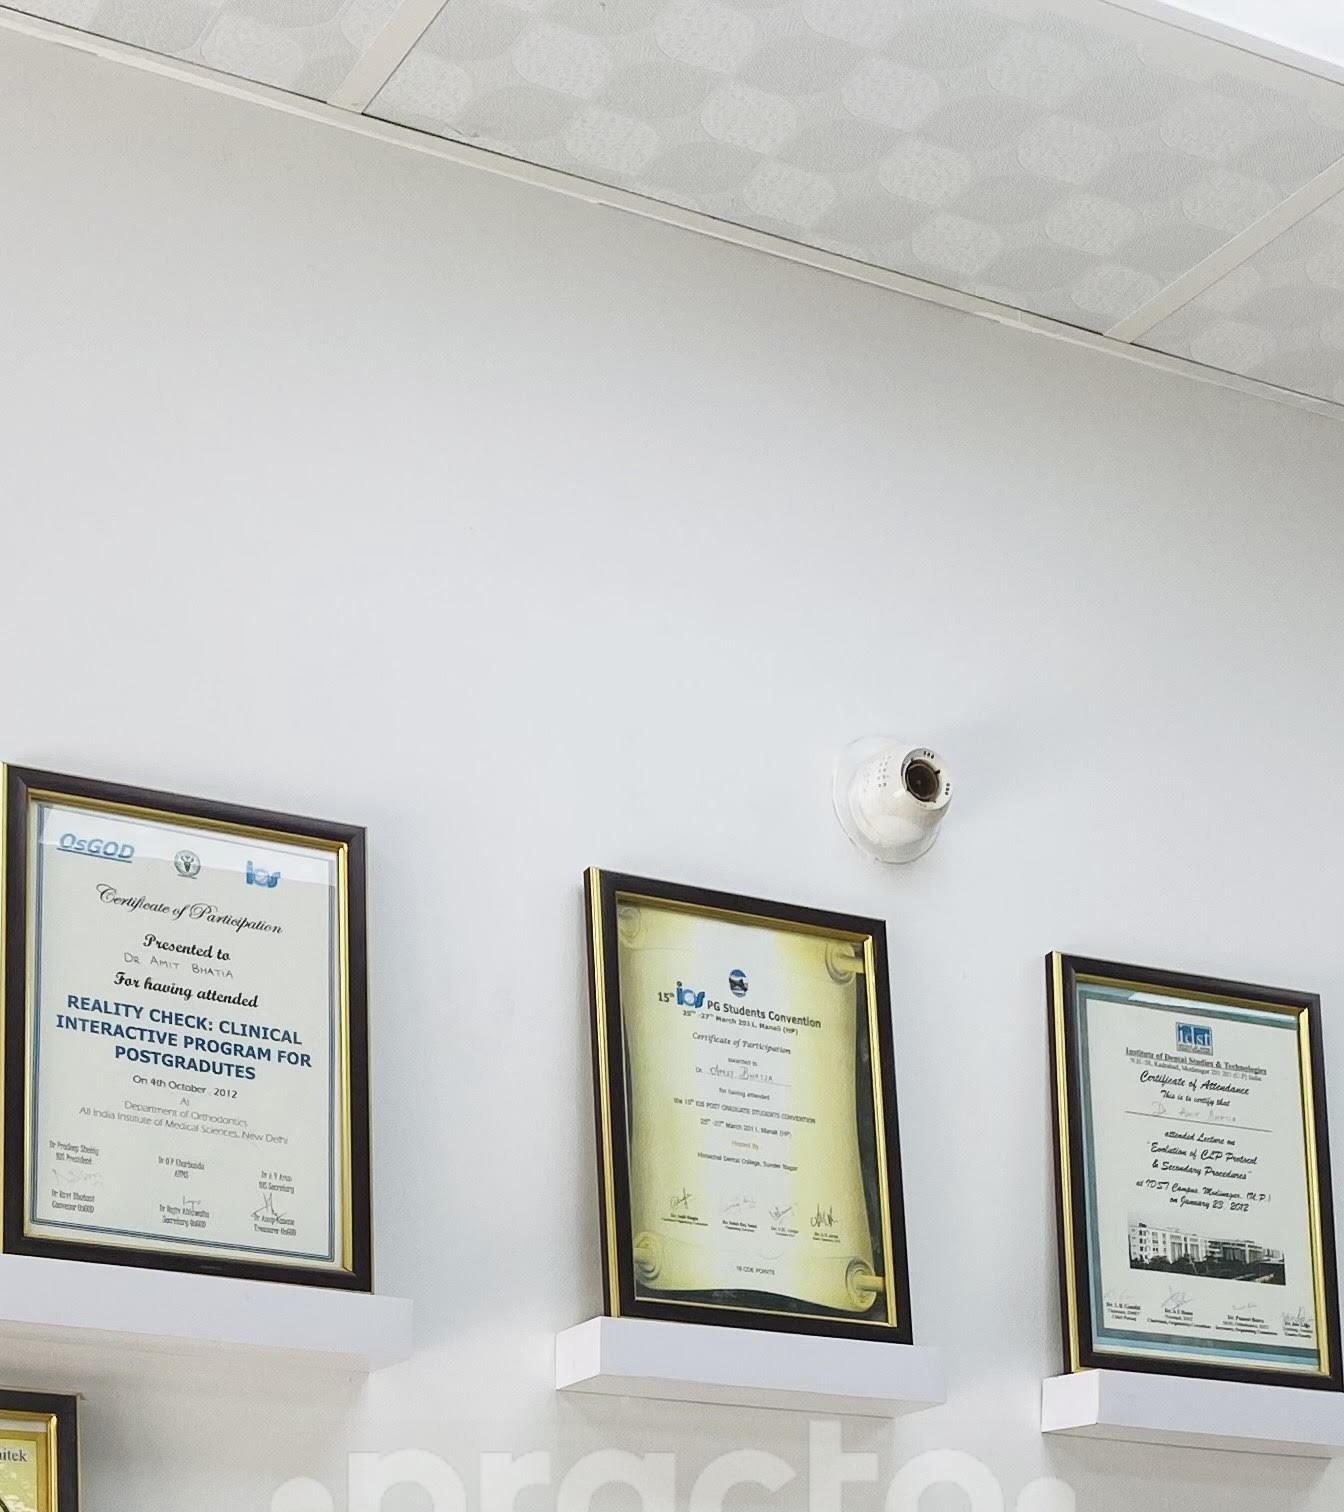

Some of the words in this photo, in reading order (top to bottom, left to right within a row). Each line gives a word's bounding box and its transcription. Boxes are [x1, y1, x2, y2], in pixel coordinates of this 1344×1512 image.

[59, 833, 134, 860] OsGOD
[96, 884, 170, 913] Certificate
[172, 904, 187, 920] of
[189, 902, 283, 934] Participation
[143, 934, 212, 959] Presented
[217, 945, 231, 960] to
[113, 971, 140, 987] For
[144, 977, 192, 1000] having
[197, 988, 258, 1008] attended
[67, 995, 143, 1019] REALITY
[149, 1009, 213, 1031] CHECK:
[219, 1021, 302, 1045] CLINICAL
[707, 1001, 720, 1011] PG
[723, 1002, 766, 1019] Students
[769, 1011, 821, 1028] Convention
[56, 1015, 178, 1046] INTERACTIVE
[184, 1035, 271, 1061] PROGRAM
[277, 1050, 312, 1067] FOR
[692, 1032, 731, 1046] Certificate
[733, 1038, 741, 1048] of
[742, 1039, 791, 1054] Participation
[115, 1045, 256, 1080] POSTGRADUTES
[1140, 1071, 1185, 1088] Certificate
[1189, 1079, 1197, 1091] of
[1200, 1080, 1249, 1095] Attendance
[1165, 1130, 1194, 1141] attended
[1197, 1133, 1225, 1145] Lecture
